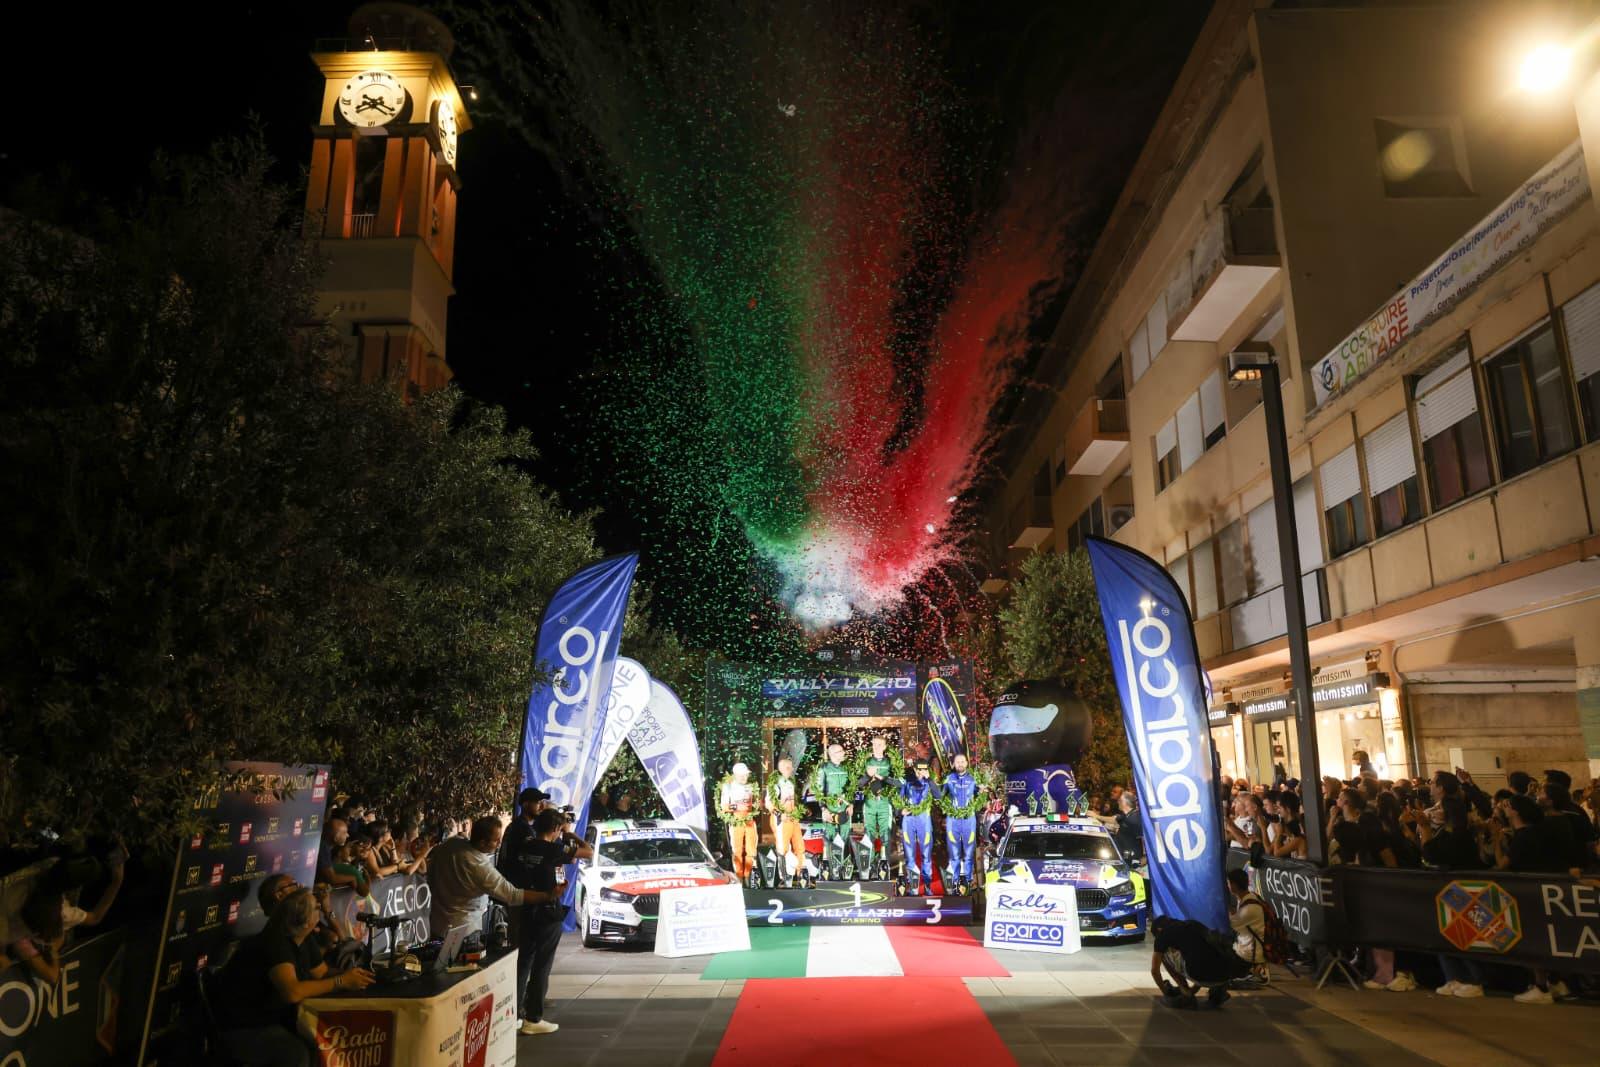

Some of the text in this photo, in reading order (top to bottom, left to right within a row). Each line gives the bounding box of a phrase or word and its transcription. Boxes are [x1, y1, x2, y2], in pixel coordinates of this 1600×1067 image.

[1341, 296, 1408, 360] COSTRUIRE
[770, 678, 912, 689] RALLY LAZIO
[1312, 669, 1352, 685] ntimissimi
[820, 690, 878, 698] CASSINO
[1313, 683, 1368, 702] intimissimi
[537, 626, 596, 806] parco
[1245, 700, 1287, 715] intimissimi
[644, 880, 699, 889] MOTUL
[849, 882, 861, 907] 1
[1266, 867, 1335, 907] REGIONE
[384, 883, 432, 917] REGIO
[767, 898, 784, 924] 2
[926, 898, 942, 924] 3
[997, 894, 1057, 914] Rally
[1541, 884, 1600, 918] RE
[806, 908, 905, 917] RALLY LAZIO
[993, 923, 1062, 942] sparco
[318, 1025, 387, 1052] Radio
